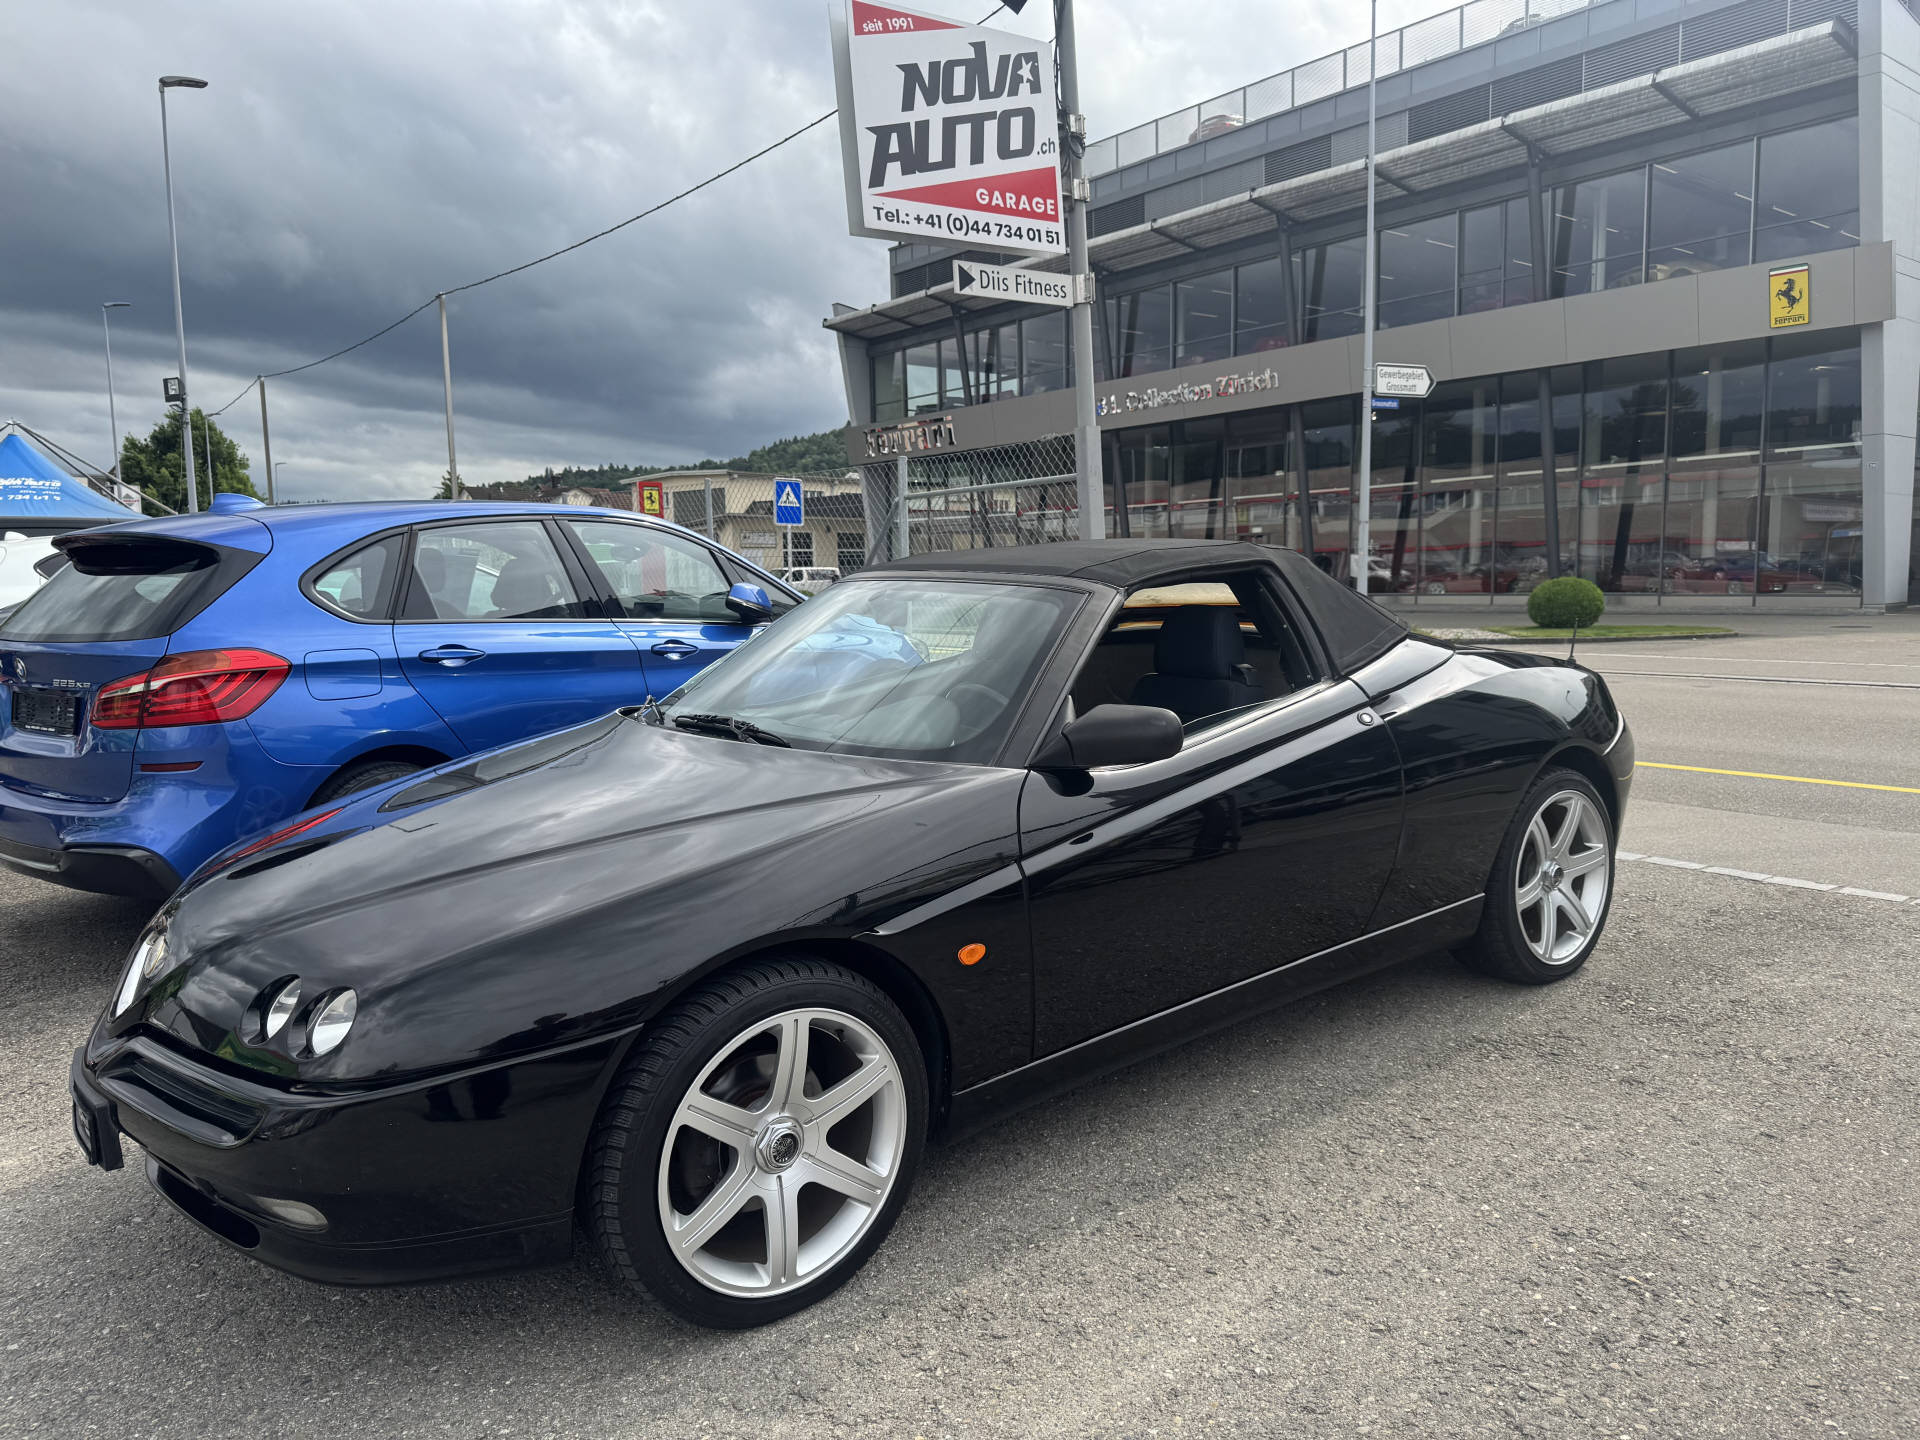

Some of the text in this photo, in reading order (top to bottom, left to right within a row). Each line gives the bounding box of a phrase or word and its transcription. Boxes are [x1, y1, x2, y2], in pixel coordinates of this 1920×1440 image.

[862, 17, 914, 32] seit 1991
[896, 40, 1042, 112] NOVA
[865, 106, 1036, 189] AUTO
[975, 188, 1056, 215] GARAGE
[873, 206, 1061, 246] Tel.: +41 (0)44 734 01 51
[979, 269, 1067, 299] Diis Fitness
[1774, 314, 1806, 325] Ferrari
[1125, 382, 1213, 411] Collection
[1215, 368, 1280, 397] Zürich
[1379, 368, 1424, 382] Gewerbegebiet
[1386, 381, 1417, 392] Grossmatt
[863, 415, 957, 457] Ferrari
